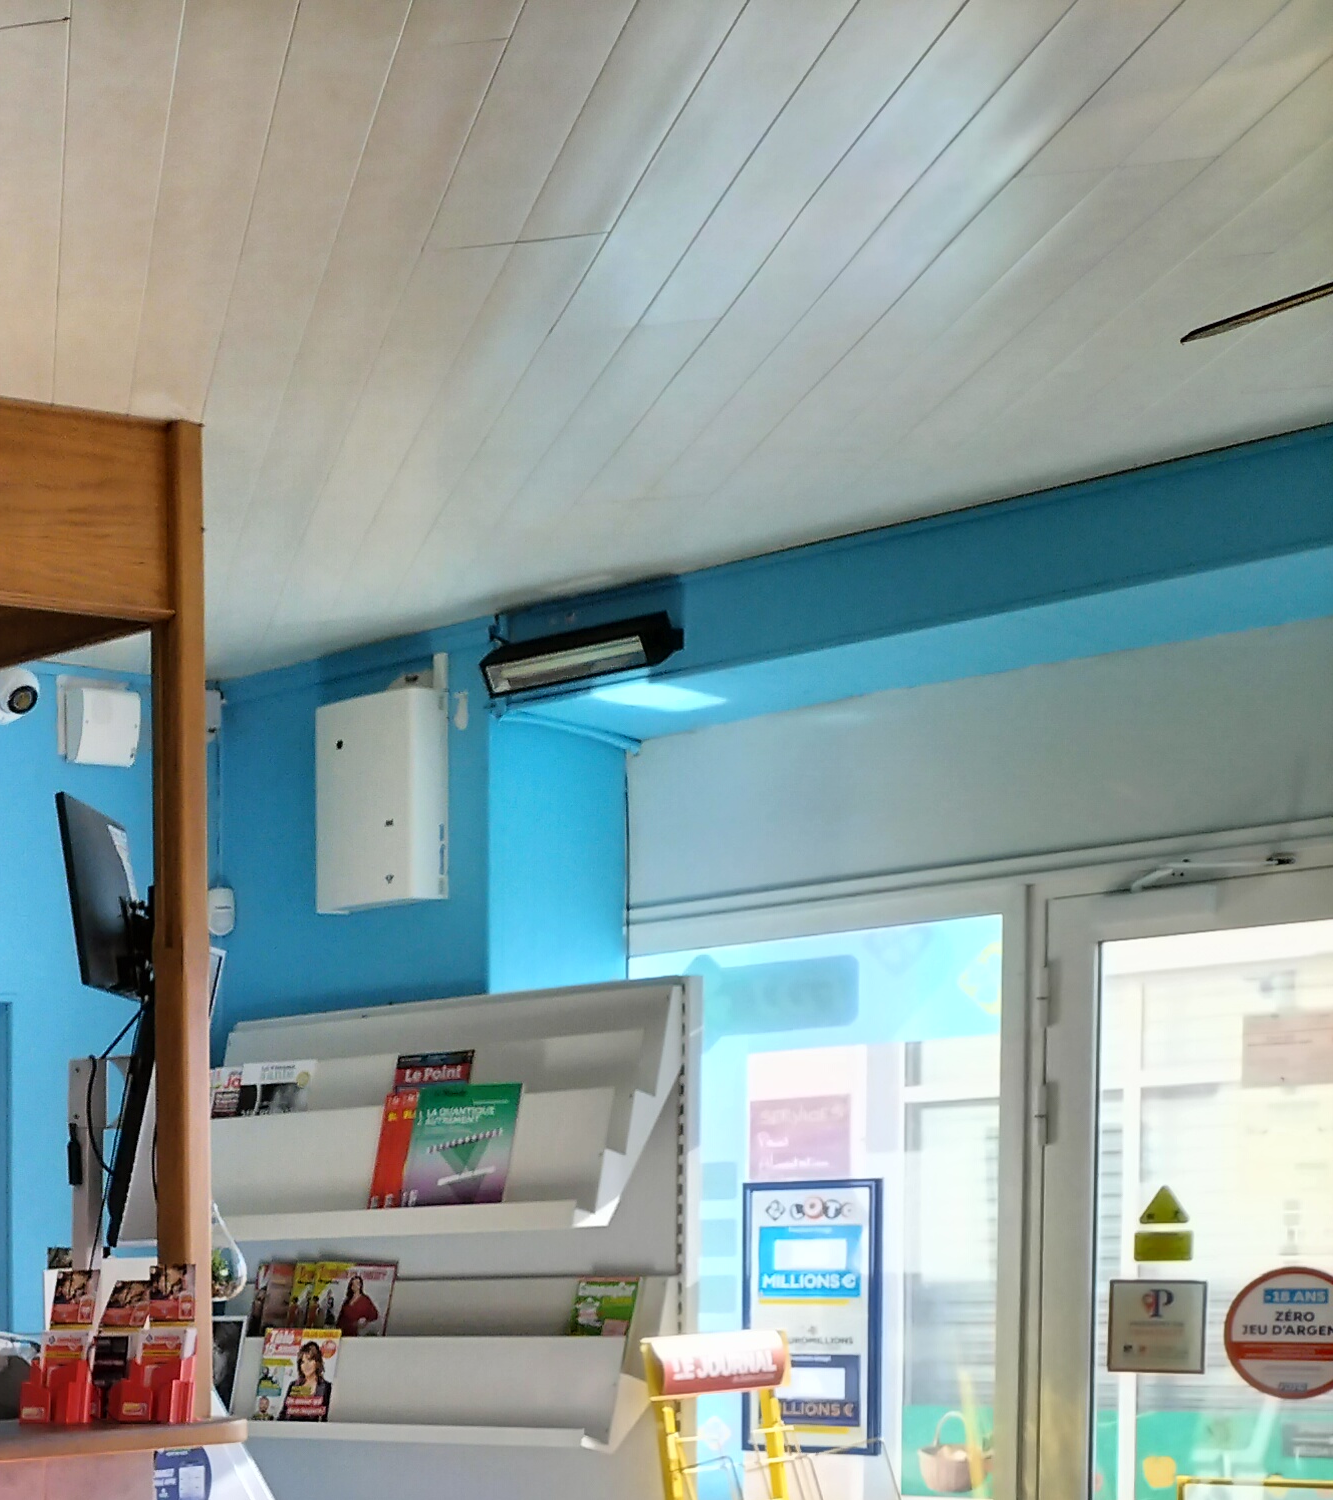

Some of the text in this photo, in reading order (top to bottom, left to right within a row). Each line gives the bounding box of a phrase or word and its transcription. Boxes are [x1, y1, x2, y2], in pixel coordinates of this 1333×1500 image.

[404, 1064, 463, 1083] Le Point
[762, 1273, 857, 1290] MILLIONS €
[1265, 1290, 1327, 1303] -18 ANS
[1275, 1309, 1316, 1322] ZÉRO
[1242, 1324, 1268, 1336] JEU
[787, 1336, 853, 1346] UROMILLIONS
[672, 1350, 777, 1381] LE JOURNAL
[842, 1403, 854, 1416] €
